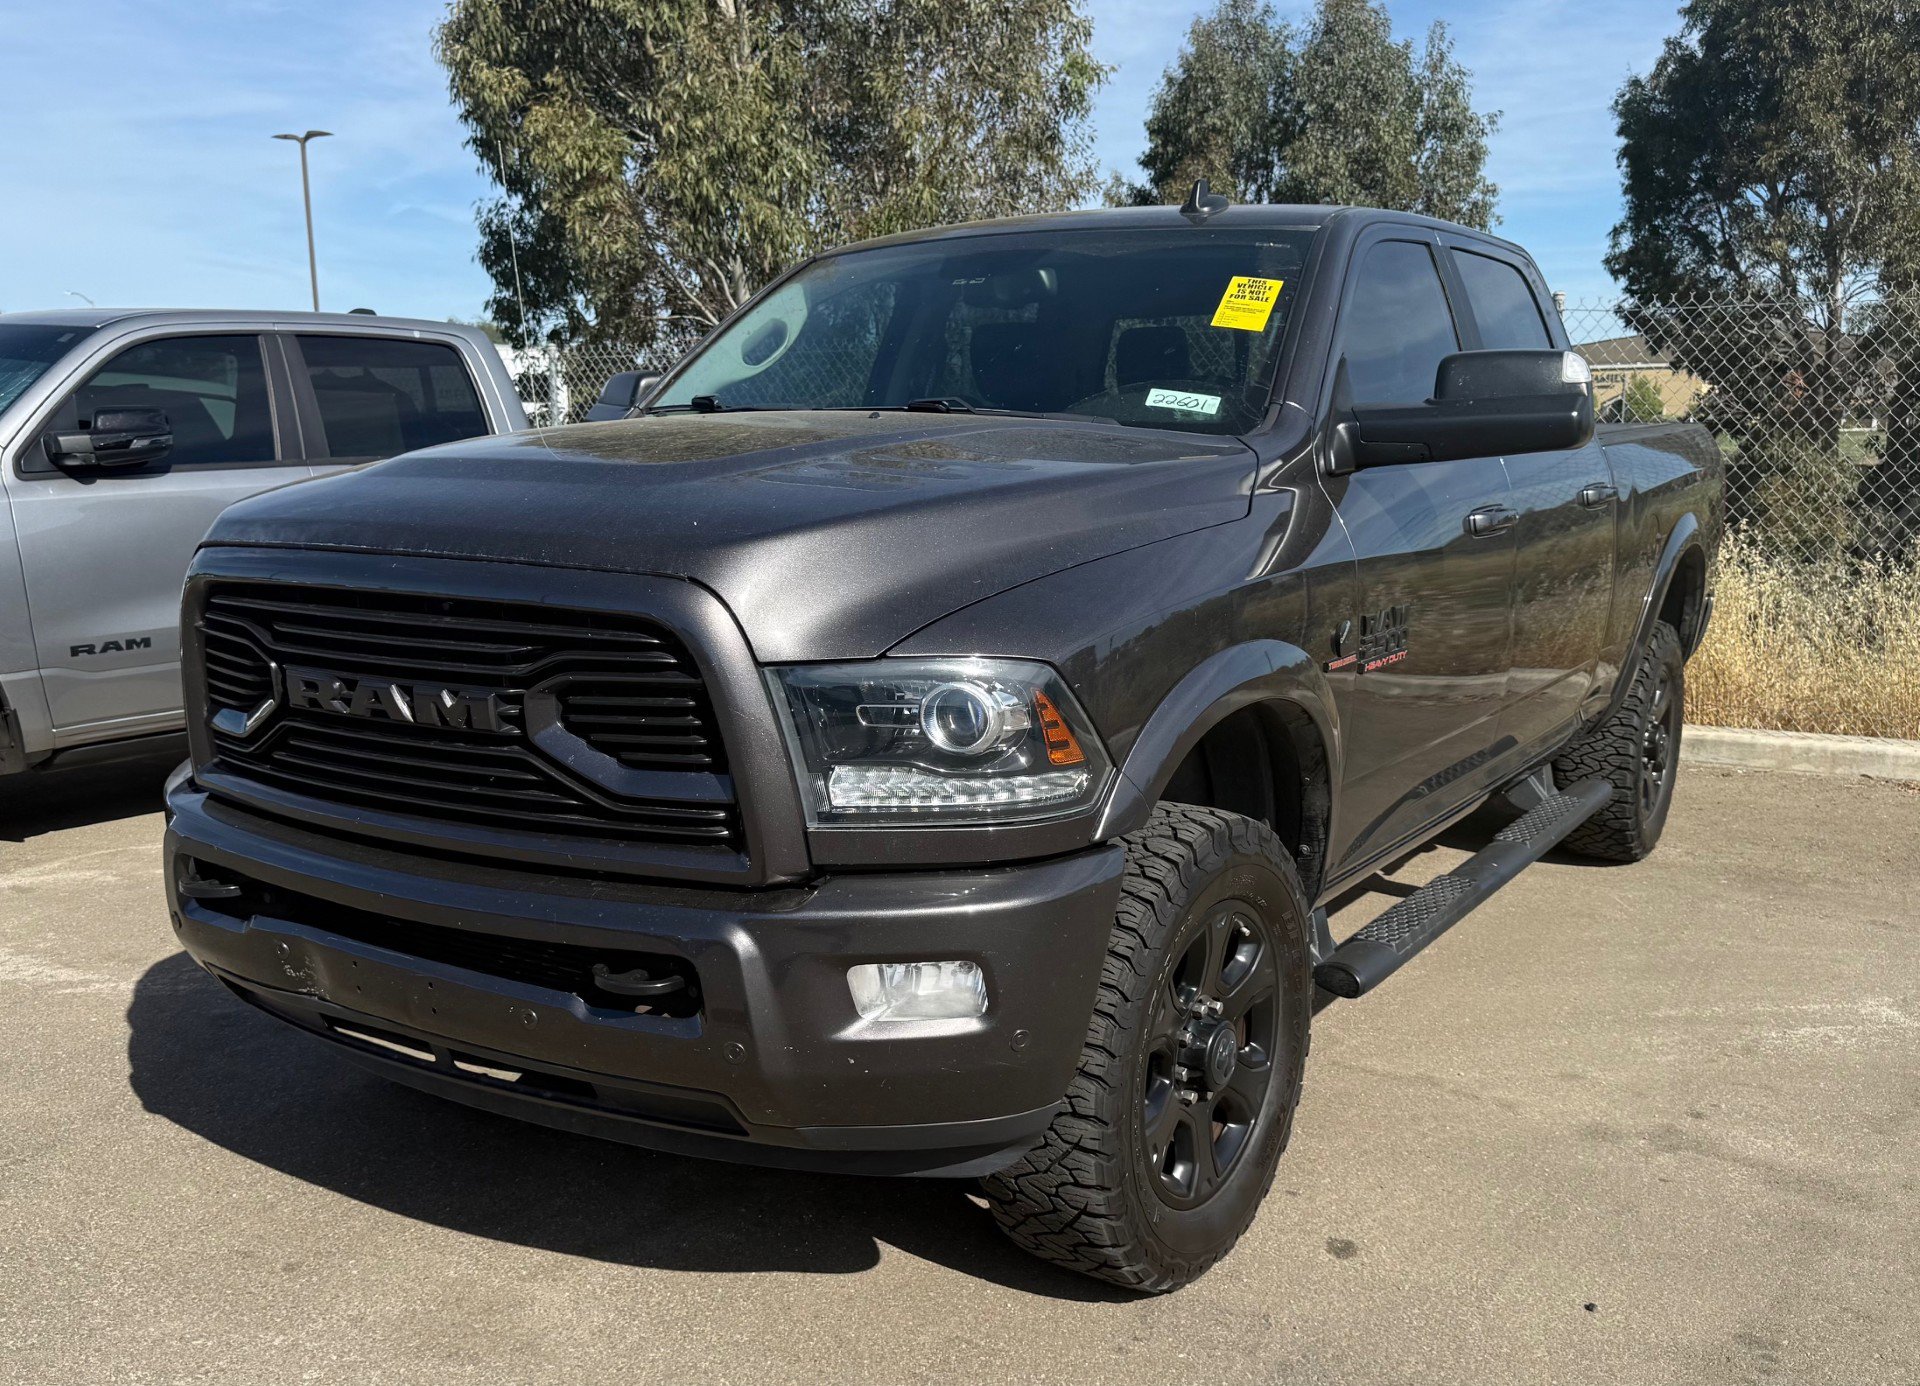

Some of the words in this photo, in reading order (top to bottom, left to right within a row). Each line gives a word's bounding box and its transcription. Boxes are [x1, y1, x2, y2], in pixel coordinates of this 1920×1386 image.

[1237, 283, 1273, 291] VEHICLE
[1153, 394, 1208, 410] 22601
[70, 637, 151, 657] RAM
[1364, 656, 1389, 672] HEAVY
[1388, 649, 1408, 663] DUTY
[284, 664, 500, 733] RAM
